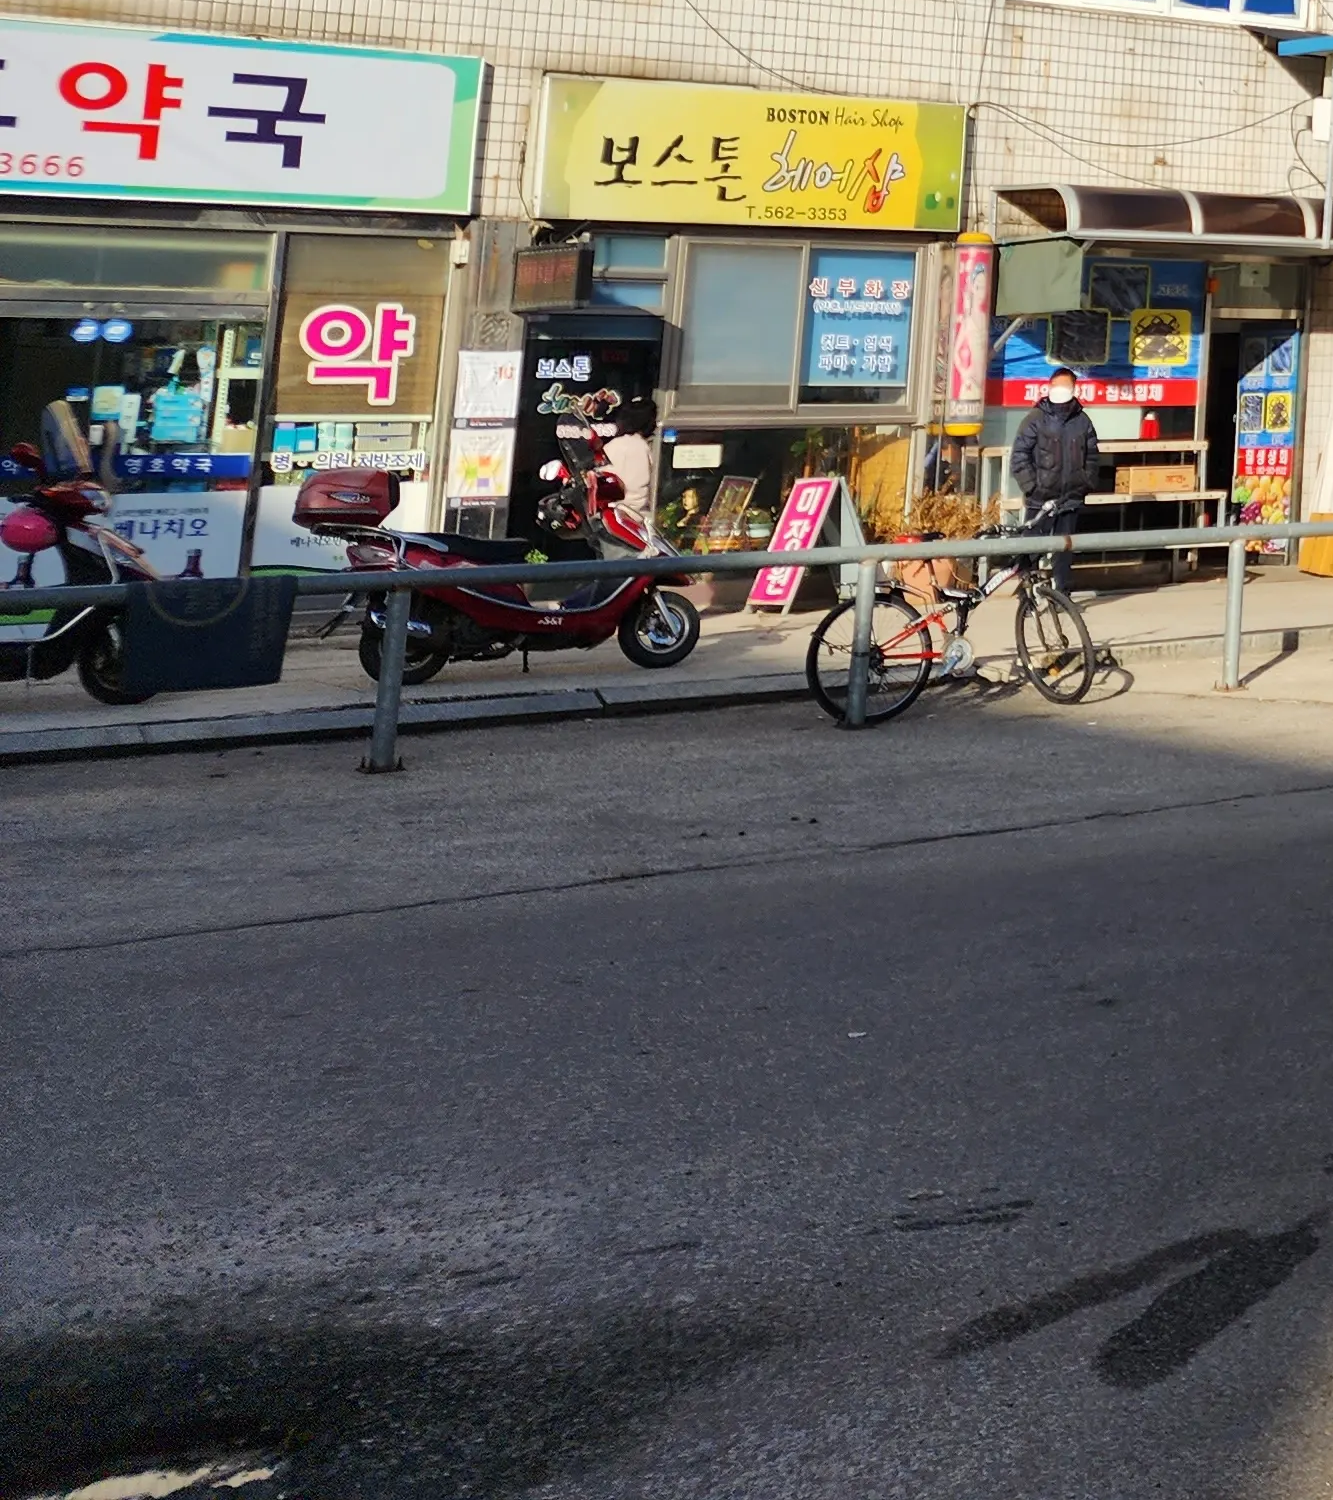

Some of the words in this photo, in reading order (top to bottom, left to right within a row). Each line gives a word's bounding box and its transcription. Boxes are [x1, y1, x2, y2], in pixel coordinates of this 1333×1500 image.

[0, 59, 327, 169] 약국
[765, 106, 831, 126] BOSTON
[834, 105, 868, 128] Hair
[870, 107, 905, 134] Shop
[593, 133, 748, 203] 보스톤
[761, 129, 907, 214] 헤어샵
[745, 204, 848, 222] T.562-3353
[808, 277, 911, 300] 신부화장
[299, 302, 416, 406] 약
[535, 355, 593, 382] 보스톤
[114, 517, 210, 541] 베나치오
[765, 485, 824, 597] 미장원
